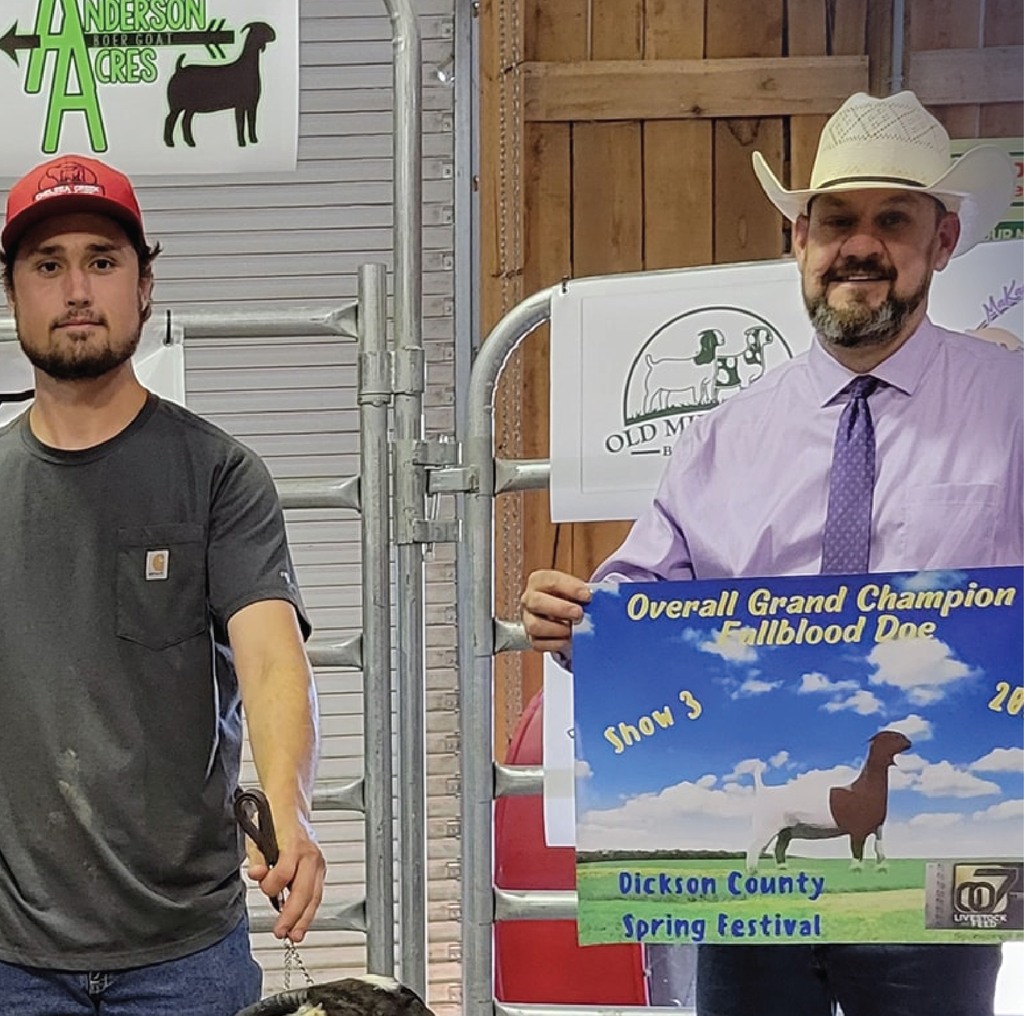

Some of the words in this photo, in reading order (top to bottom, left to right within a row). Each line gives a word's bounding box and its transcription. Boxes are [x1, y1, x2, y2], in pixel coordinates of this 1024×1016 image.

[92, 33, 129, 46] BOER
[135, 33, 174, 46] GOAT
[605, 423, 657, 453] OLD
[627, 591, 739, 621] Overall
[747, 586, 847, 615] Grand
[856, 582, 1017, 616] Champion
[719, 617, 865, 646] Fullblood
[874, 614, 937, 644] Doe
[603, 705, 675, 756] Show
[678, 689, 704, 721] 3
[618, 871, 716, 895] Dickson
[727, 870, 825, 901] County
[622, 912, 706, 942] Spring
[717, 912, 821, 938] Festival
